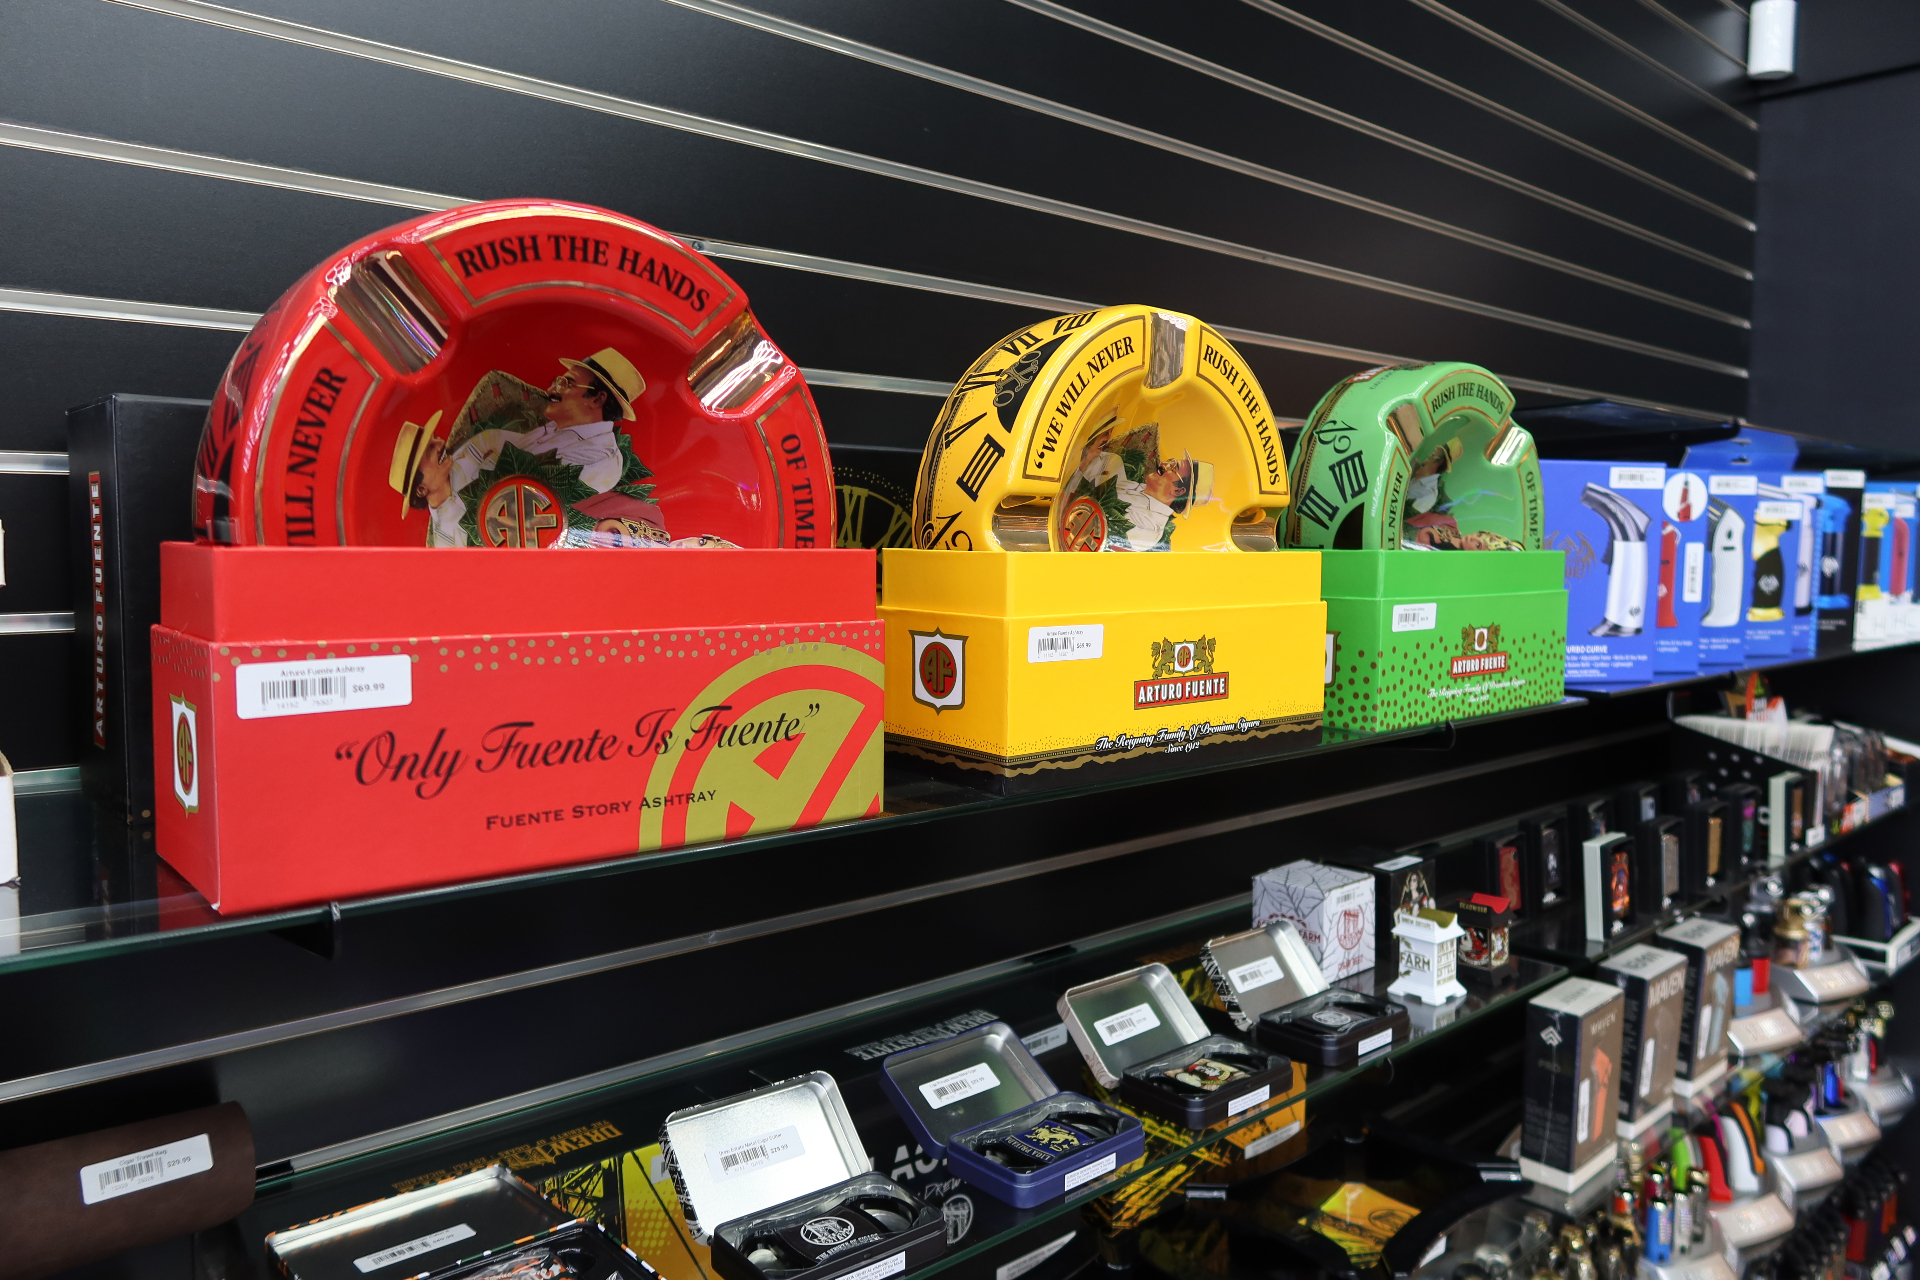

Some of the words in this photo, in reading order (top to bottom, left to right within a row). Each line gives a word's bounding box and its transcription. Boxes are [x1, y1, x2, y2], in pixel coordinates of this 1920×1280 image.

[455, 235, 542, 278] RUSH
[547, 235, 608, 266] THE
[616, 246, 710, 312] HANDS
[1055, 369, 1091, 419] WILL
[1086, 335, 1135, 379] NEVER
[1431, 384, 1456, 413] RUSH
[1457, 382, 1475, 397] THE
[1477, 384, 1505, 412] HANDS
[286, 366, 347, 479] NEVER
[1203, 344, 1239, 386] RUSH
[1237, 379, 1262, 419] THE
[1255, 416, 1280, 486] HANDS
[781, 433, 808, 472] OF
[1526, 471, 1537, 493] OF
[1389, 472, 1404, 530] NEVER
[285, 486, 316, 547] ILL
[90, 481, 104, 604] FUENTE
[1586, 645, 1608, 653] CURVE
[95, 612, 105, 738] ARTURO
[307, 667, 334, 676] Fuente
[1452, 658, 1480, 675] ARTURO
[1481, 655, 1506, 671] FUENTE
[352, 682, 386, 694] $69.99
[1138, 682, 1183, 704] ARTURO
[1185, 677, 1226, 698] FUENTE
[1427, 688, 1438, 698] The
[1095, 736, 1115, 751] The
[1115, 733, 1155, 750] Reigning
[1156, 728, 1188, 743] Family
[1188, 724, 1200, 740] Of
[1199, 721, 1236, 736] Premium
[1237, 716, 1262, 732] Cigars
[334, 727, 468, 801] “Only
[475, 720, 623, 774] Fuente
[628, 707, 680, 758] Is
[685, 702, 820, 752] Fuente”
[1165, 742, 1184, 754] Since
[1184, 740, 1200, 753] 1912
[486, 809, 565, 830] FUENTE
[572, 799, 632, 819] STORY
[638, 788, 717, 811] ASHTRAY
[1400, 952, 1431, 971] FARM
[1648, 967, 1687, 1008] MAVEN
[944, 1011, 999, 1031] DREW
[853, 1033, 926, 1060] ESTATE
[549, 1127, 588, 1142] REBIRTH
[590, 1120, 609, 1129] THE
[496, 1144, 530, 1158] CIGARS
[534, 1137, 546, 1147] OF
[548, 1123, 623, 1155] DREW
[1004, 1136, 1033, 1153] PRIVADA
[166, 1155, 192, 1168] $29.99
[1031, 1150, 1051, 1161] LIGA
[924, 1178, 962, 1200] DREW
